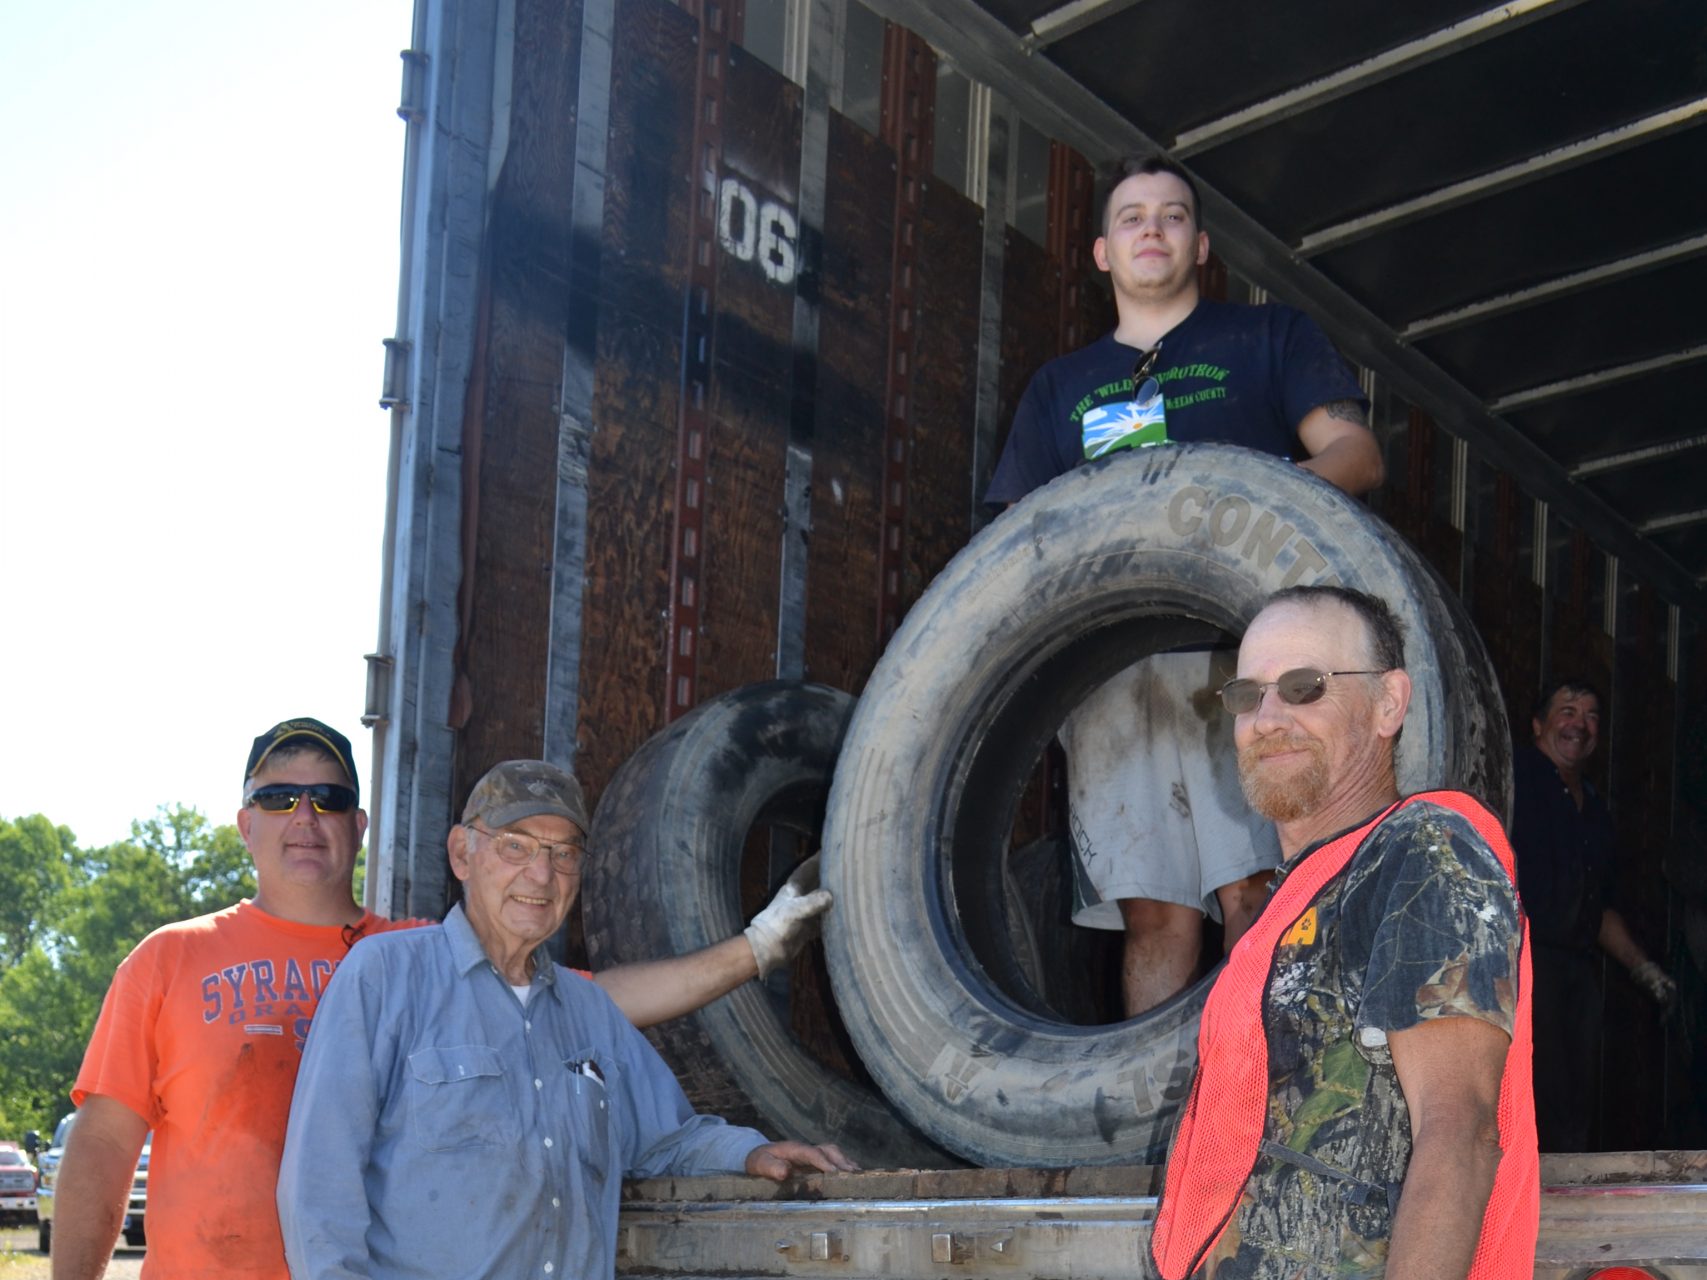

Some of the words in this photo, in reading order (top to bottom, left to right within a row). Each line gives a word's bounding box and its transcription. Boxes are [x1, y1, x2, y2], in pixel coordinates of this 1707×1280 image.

[719, 179, 797, 284] 06
[1070, 394, 1095, 423] THE
[1195, 387, 1227, 404] COUNTY
[1168, 486, 1338, 588] CONT
[202, 957, 341, 1024] SYRAC
